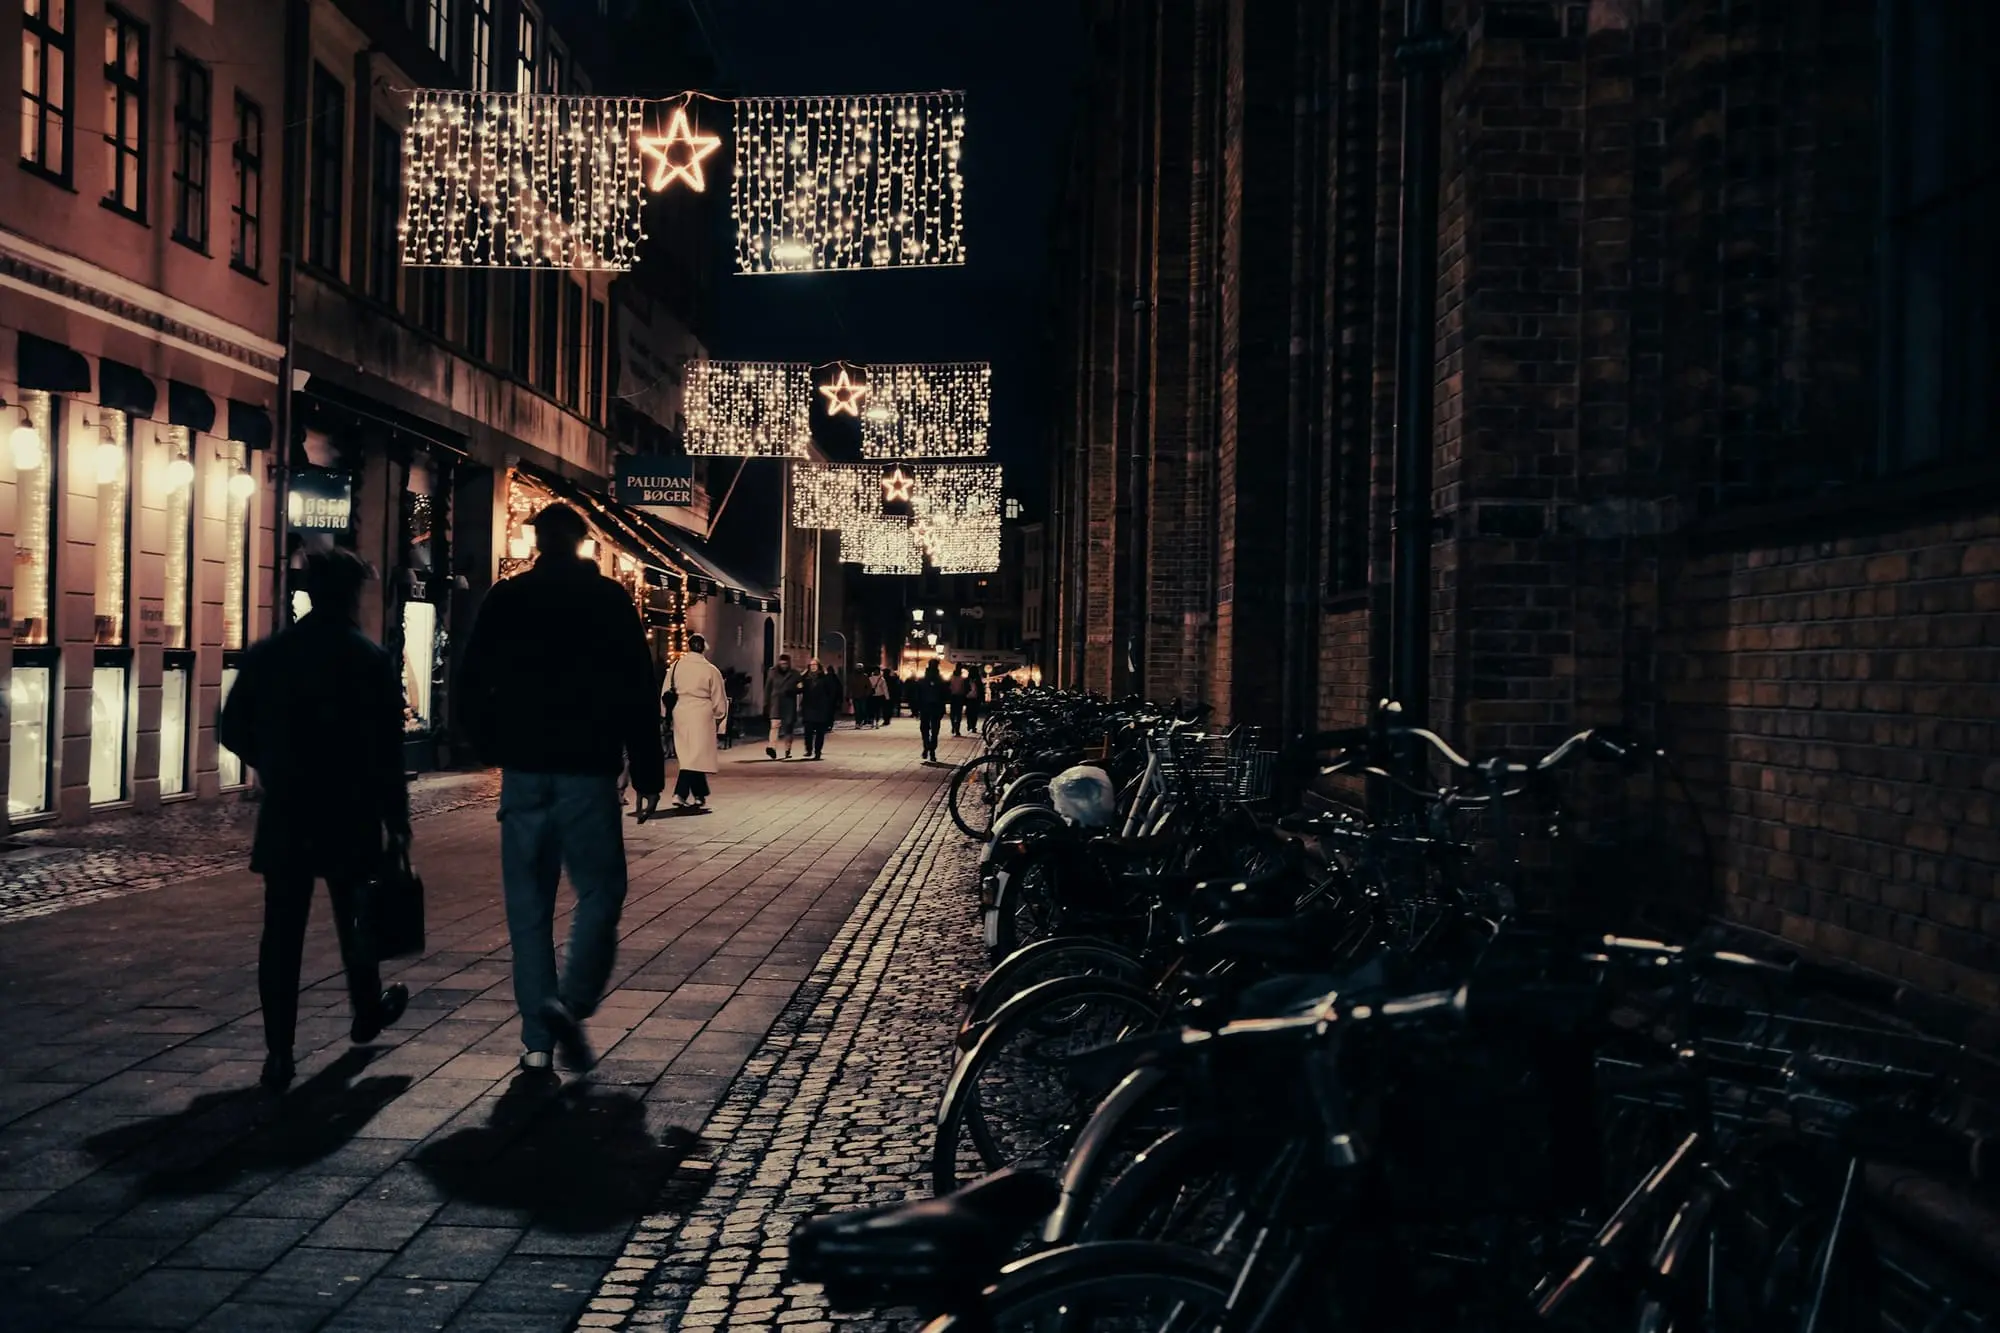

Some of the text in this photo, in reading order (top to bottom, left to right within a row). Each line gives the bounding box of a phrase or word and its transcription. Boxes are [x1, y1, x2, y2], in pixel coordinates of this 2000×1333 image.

[627, 476, 691, 488] PALUDAN
[643, 490, 690, 502] BØGER
[294, 497, 349, 516] ØGER
[306, 515, 348, 529] BISTRO
